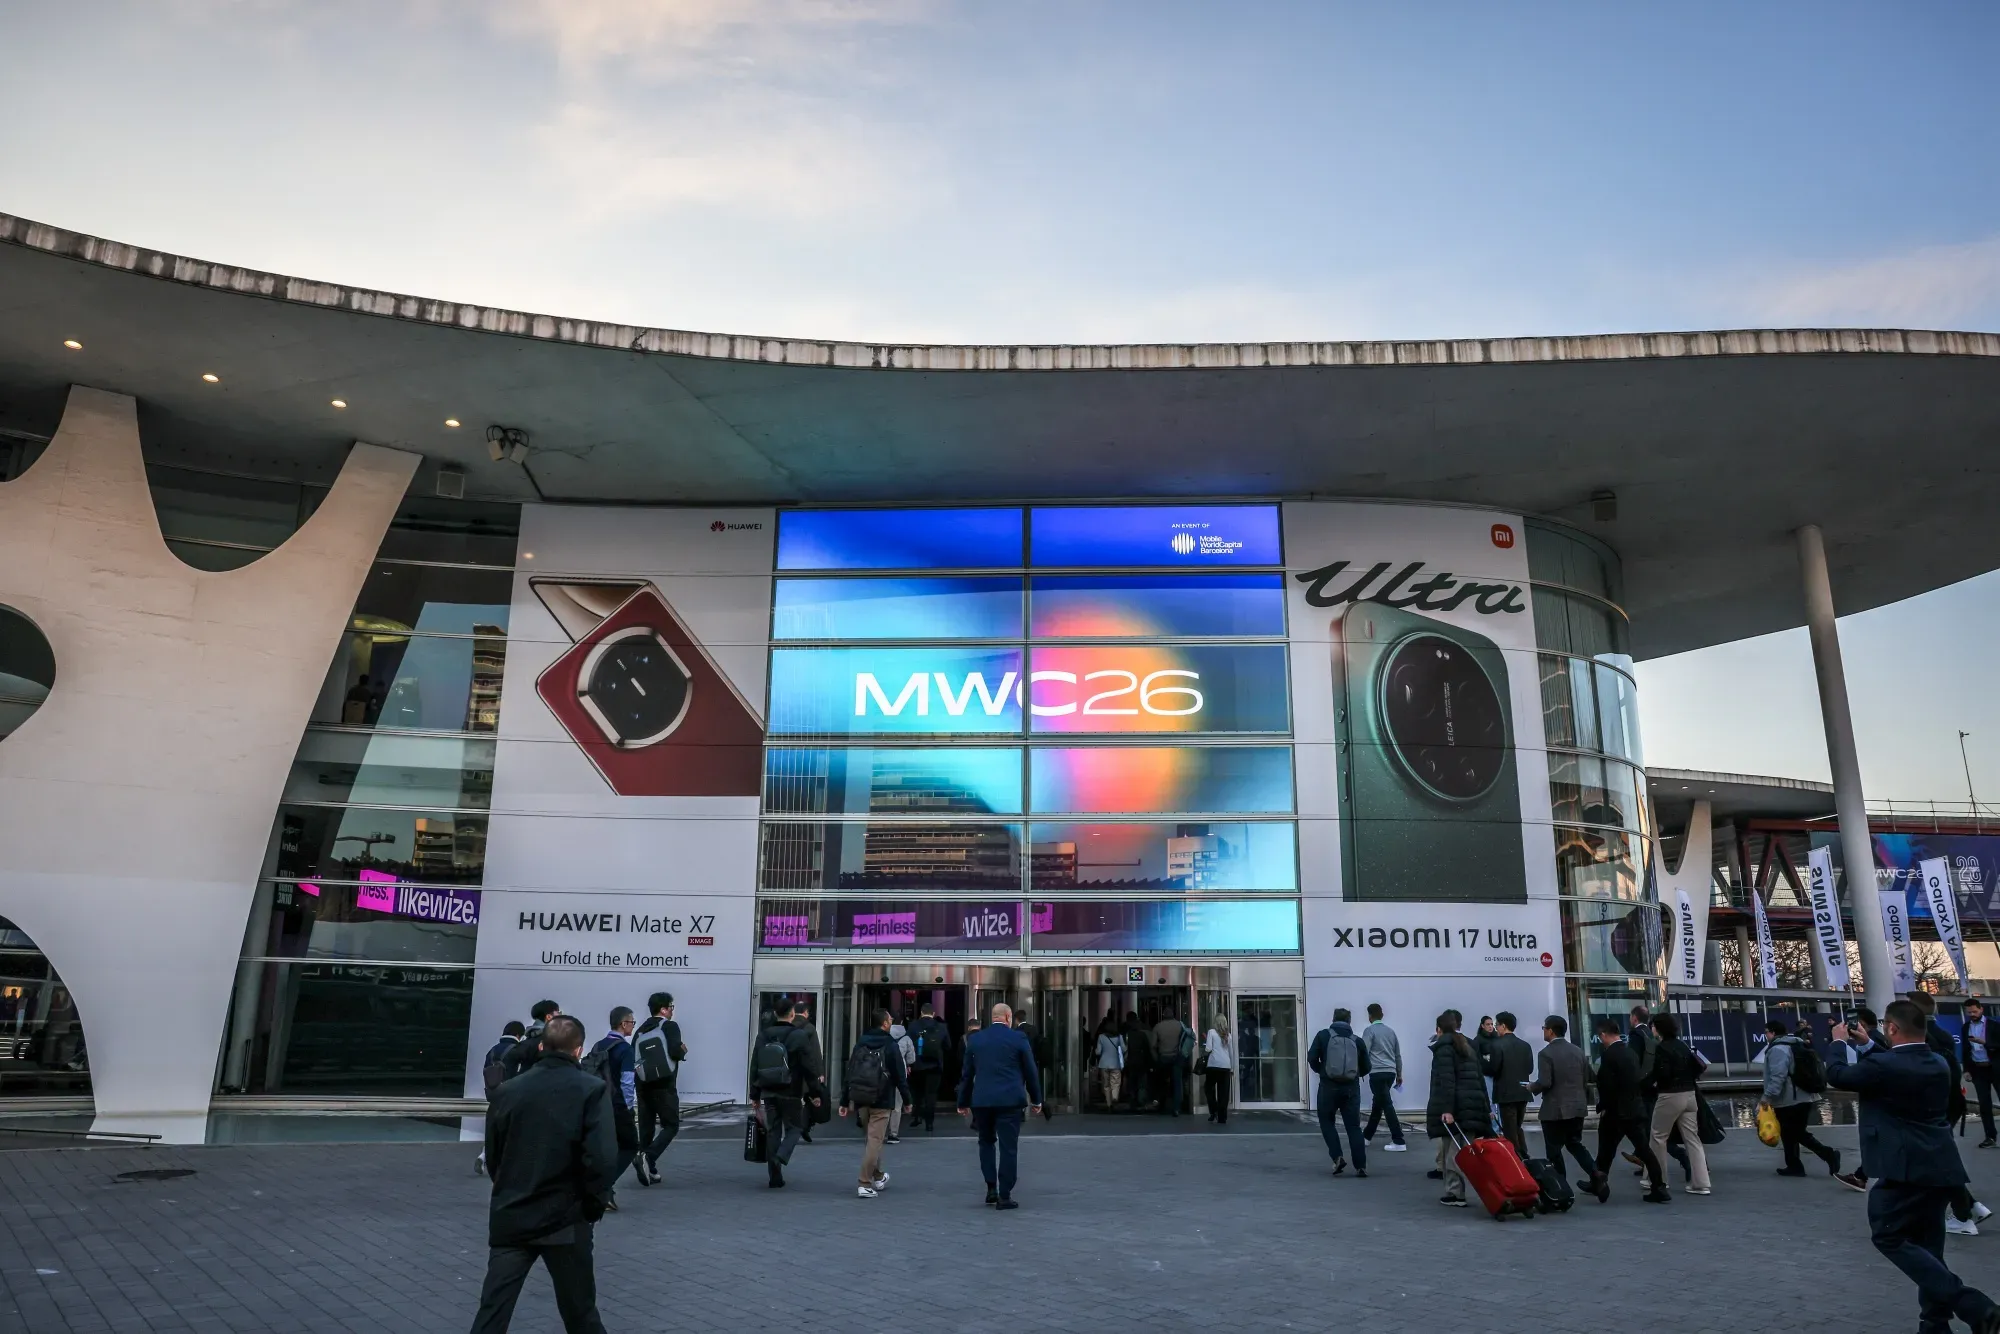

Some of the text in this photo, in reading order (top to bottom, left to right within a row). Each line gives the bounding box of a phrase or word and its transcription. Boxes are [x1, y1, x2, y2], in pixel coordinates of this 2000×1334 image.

[1200, 541, 1243, 549] WorldCapital
[1295, 561, 1526, 615] Ultra
[854, 669, 1204, 717] MWC26
[1446, 721, 1455, 746] LEICA
[399, 879, 478, 925] likewize.
[518, 911, 716, 934] HUAWEI Mate X7
[1458, 928, 1480, 949] 17
[1488, 929, 1538, 949] Ultra
[1681, 902, 1696, 980] SAMSUNG
[541, 951, 689, 967] Unfold the Moment
[1766, 951, 1775, 963] AI
